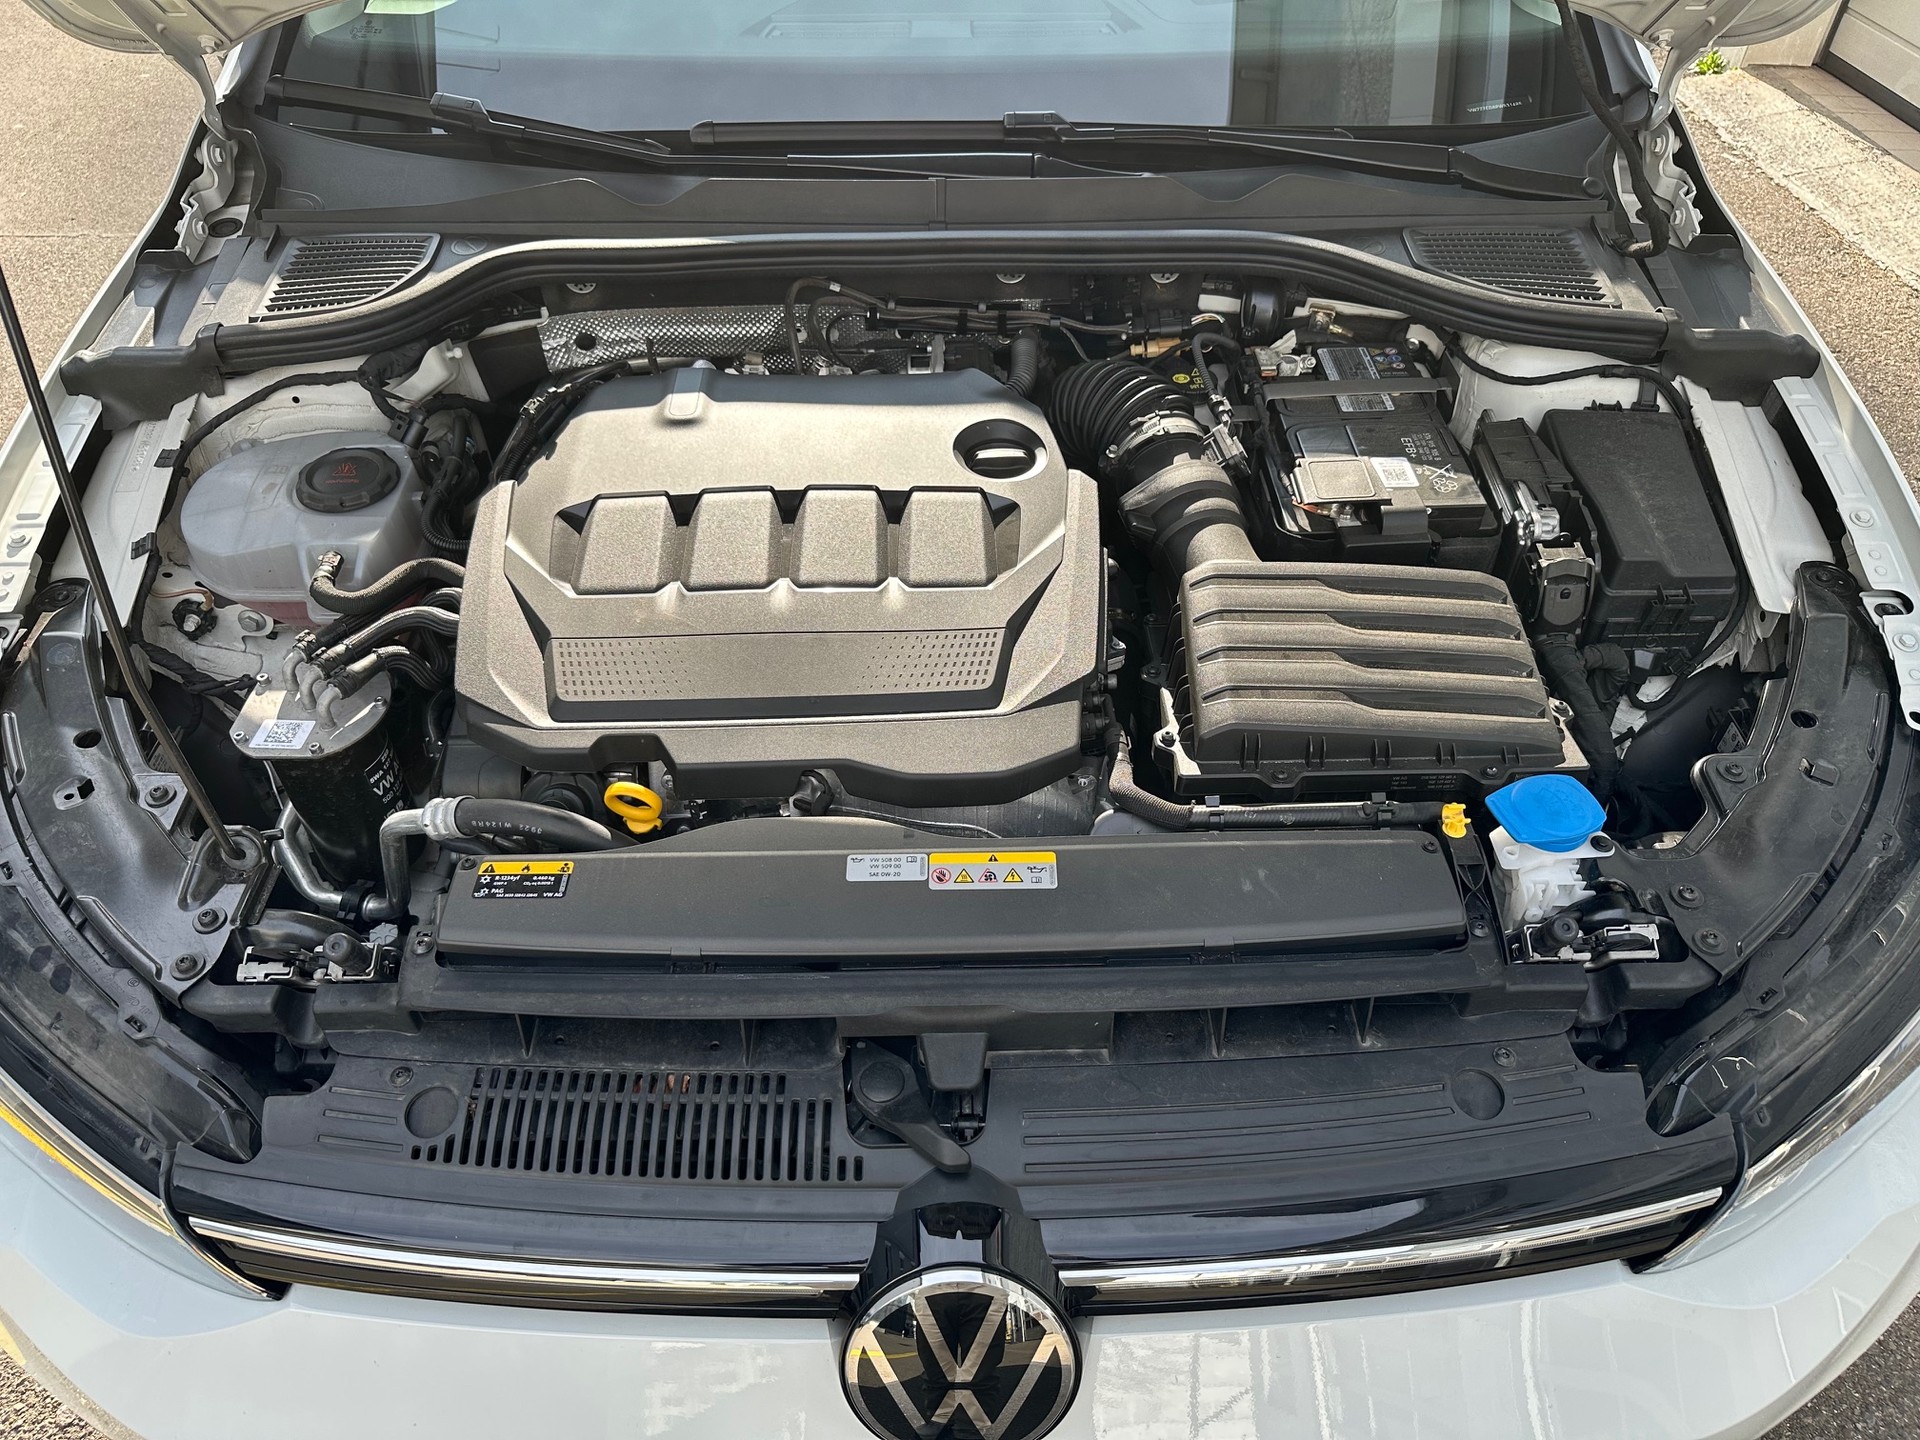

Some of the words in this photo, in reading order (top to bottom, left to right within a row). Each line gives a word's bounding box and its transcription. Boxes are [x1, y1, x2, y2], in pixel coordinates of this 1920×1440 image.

[1401, 437, 1417, 458] EFB+
[373, 770, 394, 796] VW
[846, 1276, 1078, 1440] VW
